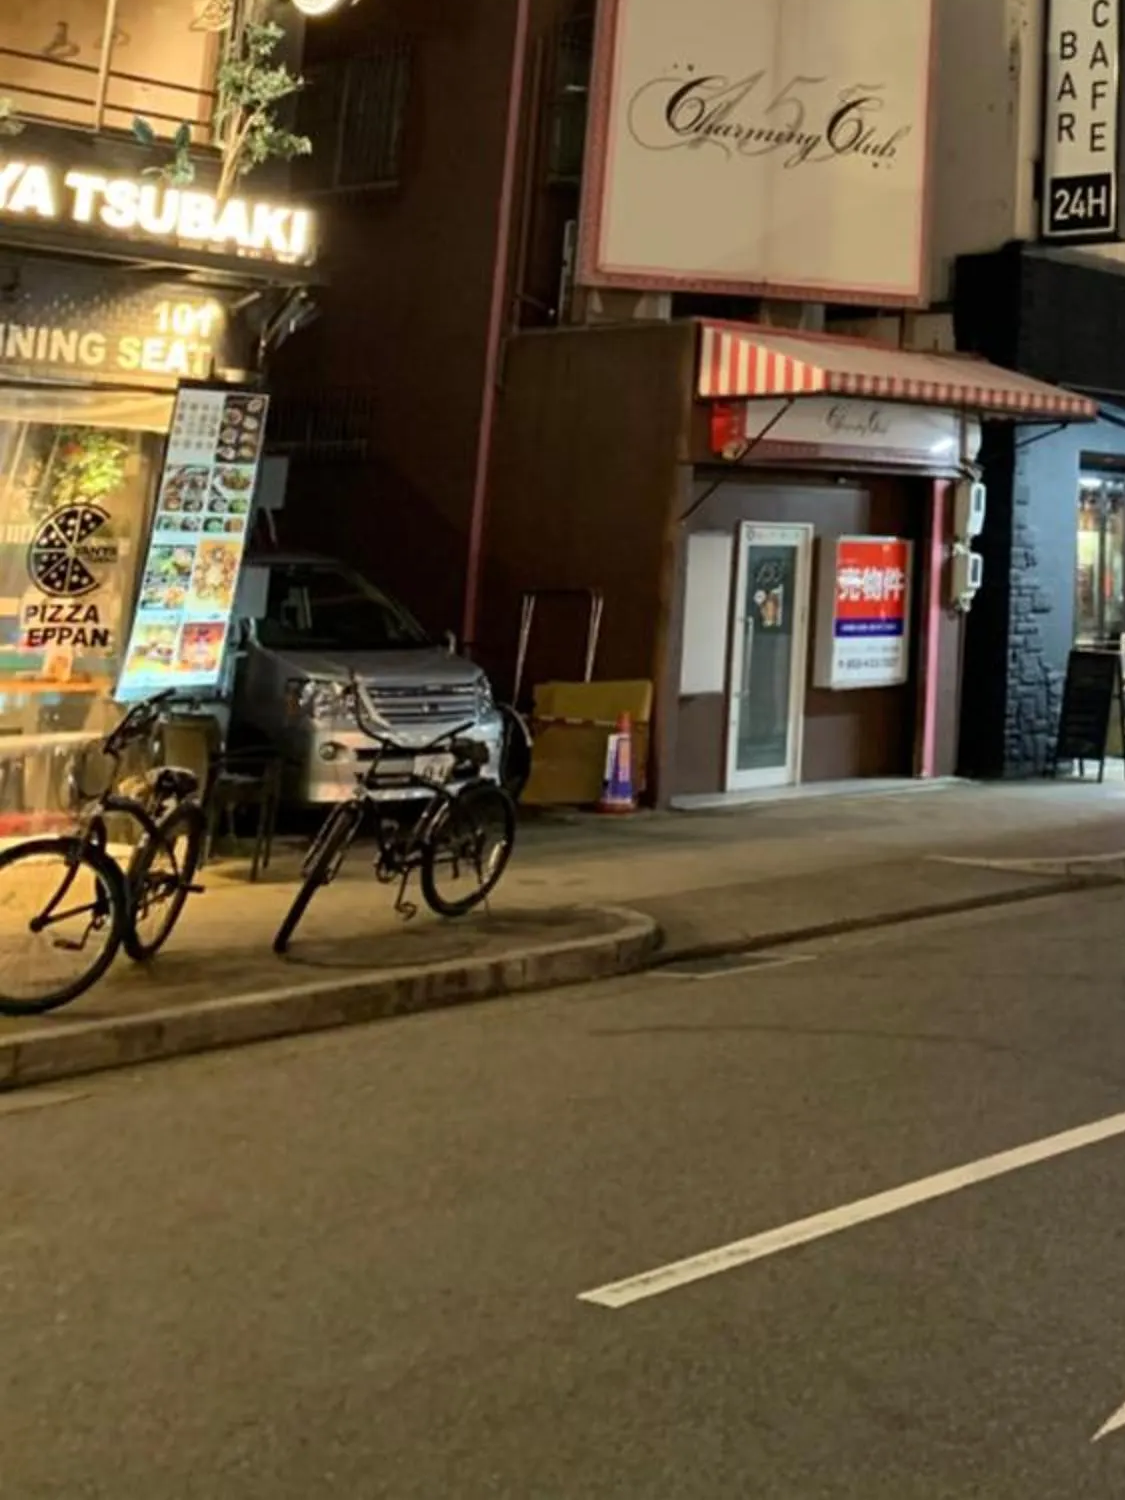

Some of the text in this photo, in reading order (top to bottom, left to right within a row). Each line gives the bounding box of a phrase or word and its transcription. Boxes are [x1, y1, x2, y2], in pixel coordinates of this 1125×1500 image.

[1057, 30, 1078, 143] BAR
[64, 170, 312, 256] TSUBAKI
[1054, 185, 1107, 220] 24H
[117, 336, 214, 378] SEAT
[25, 603, 99, 624] PIZZA
